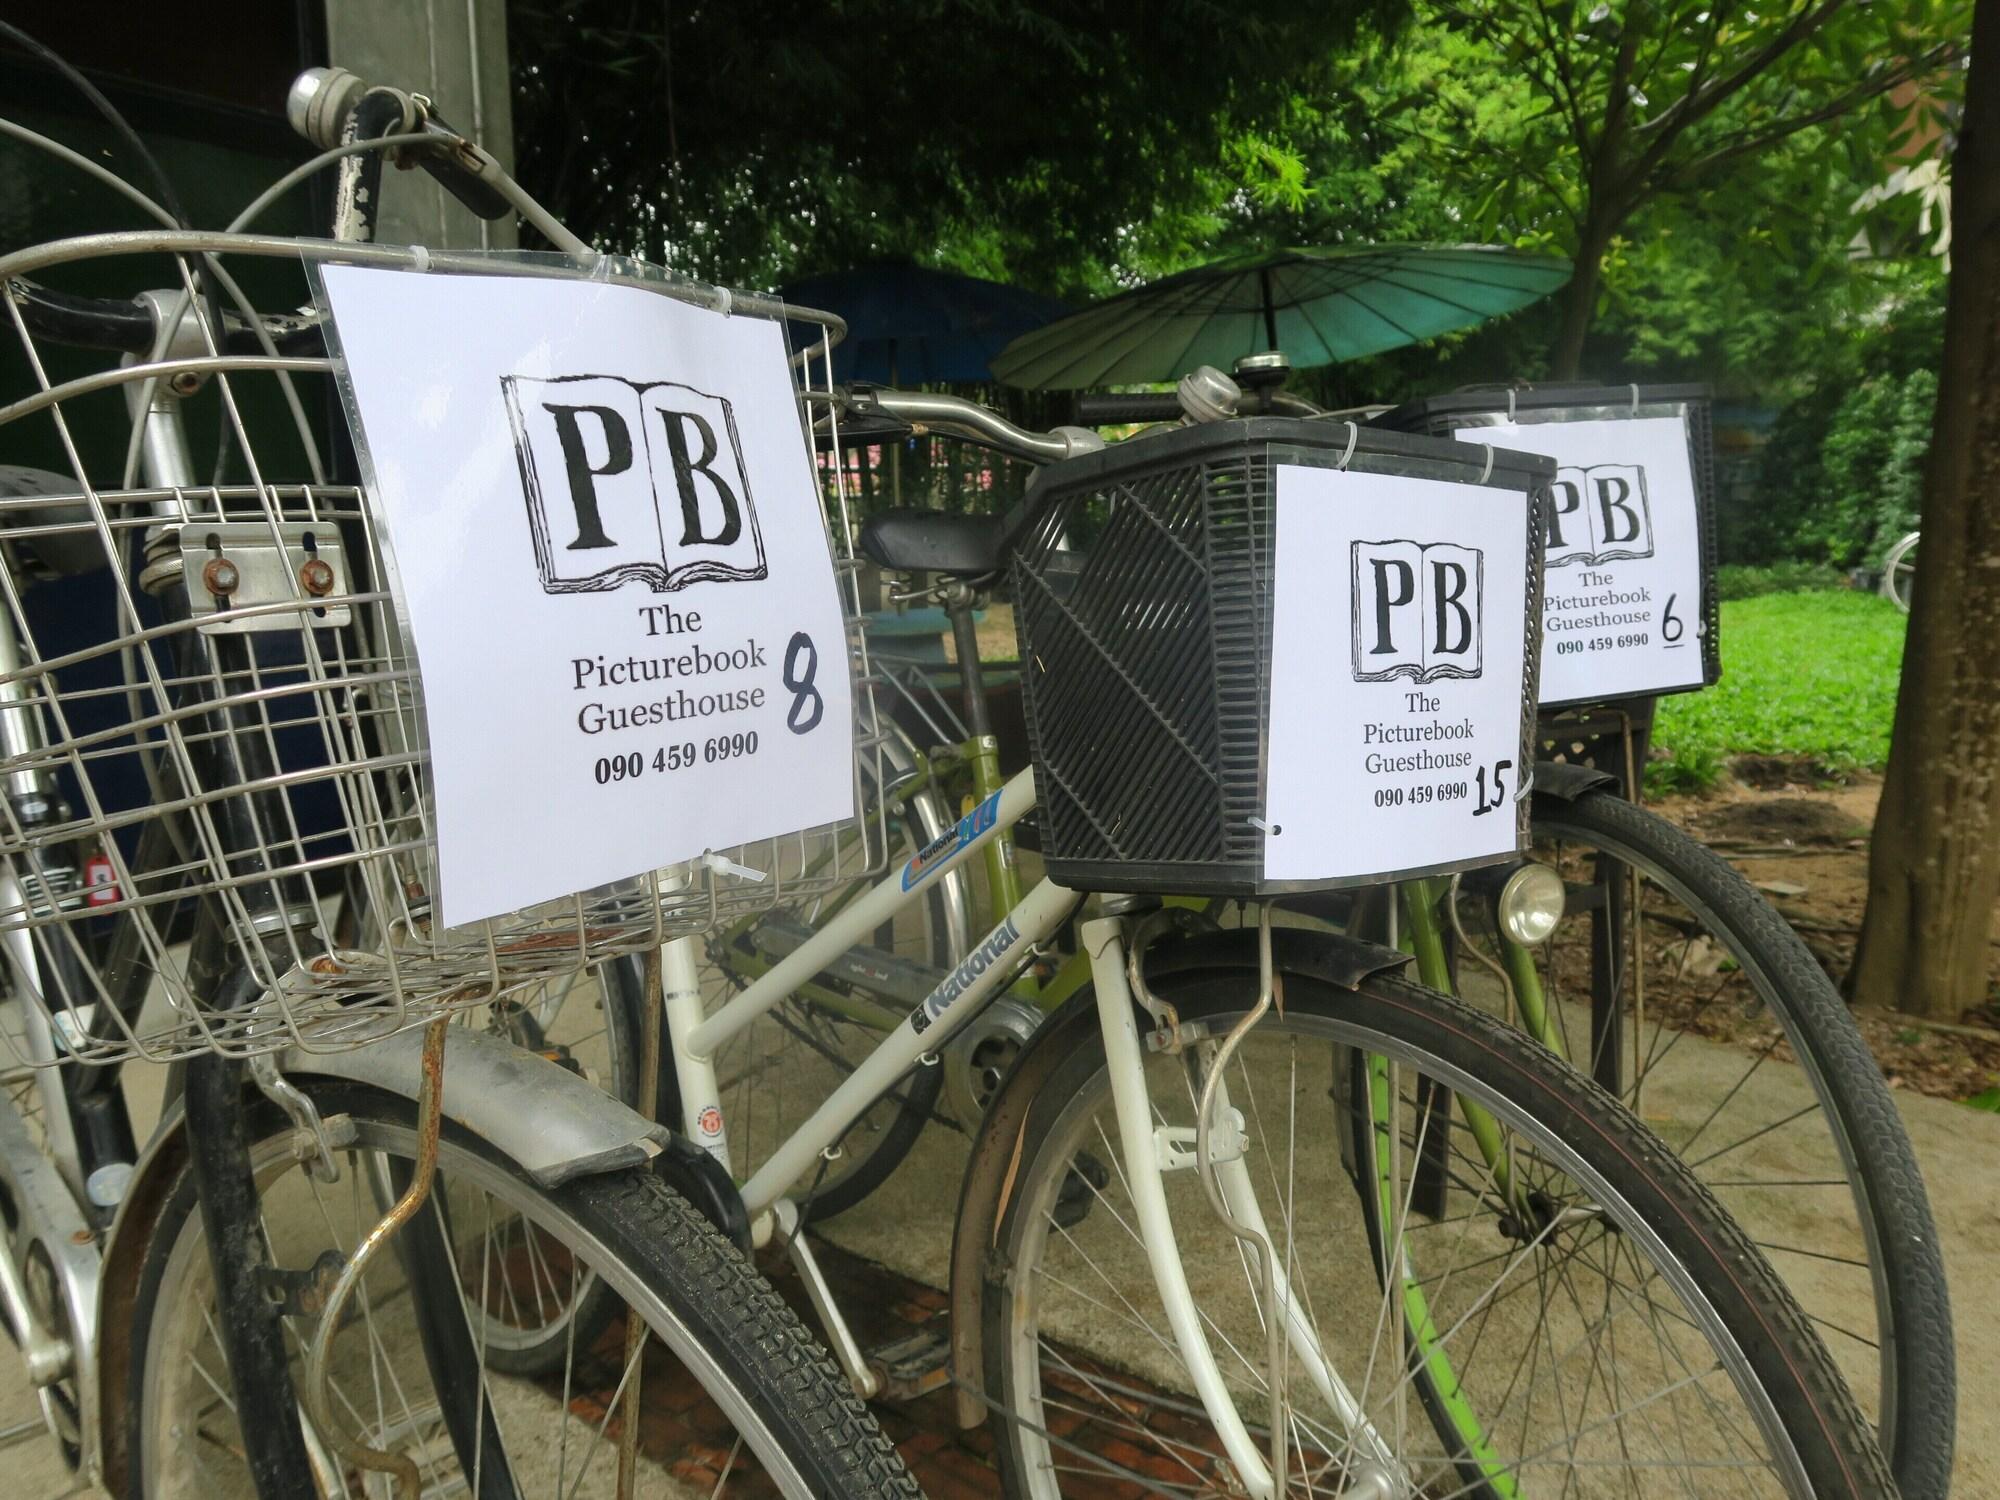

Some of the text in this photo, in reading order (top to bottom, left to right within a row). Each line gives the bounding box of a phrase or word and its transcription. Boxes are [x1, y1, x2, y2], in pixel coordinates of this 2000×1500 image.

[542, 402, 742, 550] PB
[1578, 571, 1614, 587] The
[1369, 558, 1472, 655] PB
[1543, 587, 1652, 612] Picturebook
[1662, 593, 1684, 642] 6
[639, 604, 703, 636] The
[1546, 610, 1651, 632] Guesthouse
[1557, 633, 1649, 655] 090 459 6990
[572, 639, 767, 690] Picturebook
[783, 631, 824, 735] 8
[577, 688, 766, 735] Guesthouse
[1405, 692, 1440, 713] The
[1363, 718, 1474, 744] Picturebook
[594, 730, 759, 784] 090 459 6990
[1365, 749, 1472, 774] Guesthouse
[1374, 781, 1467, 808] 090 459 6990
[1472, 760, 1512, 816] 15
[928, 915, 1020, 1017] National
